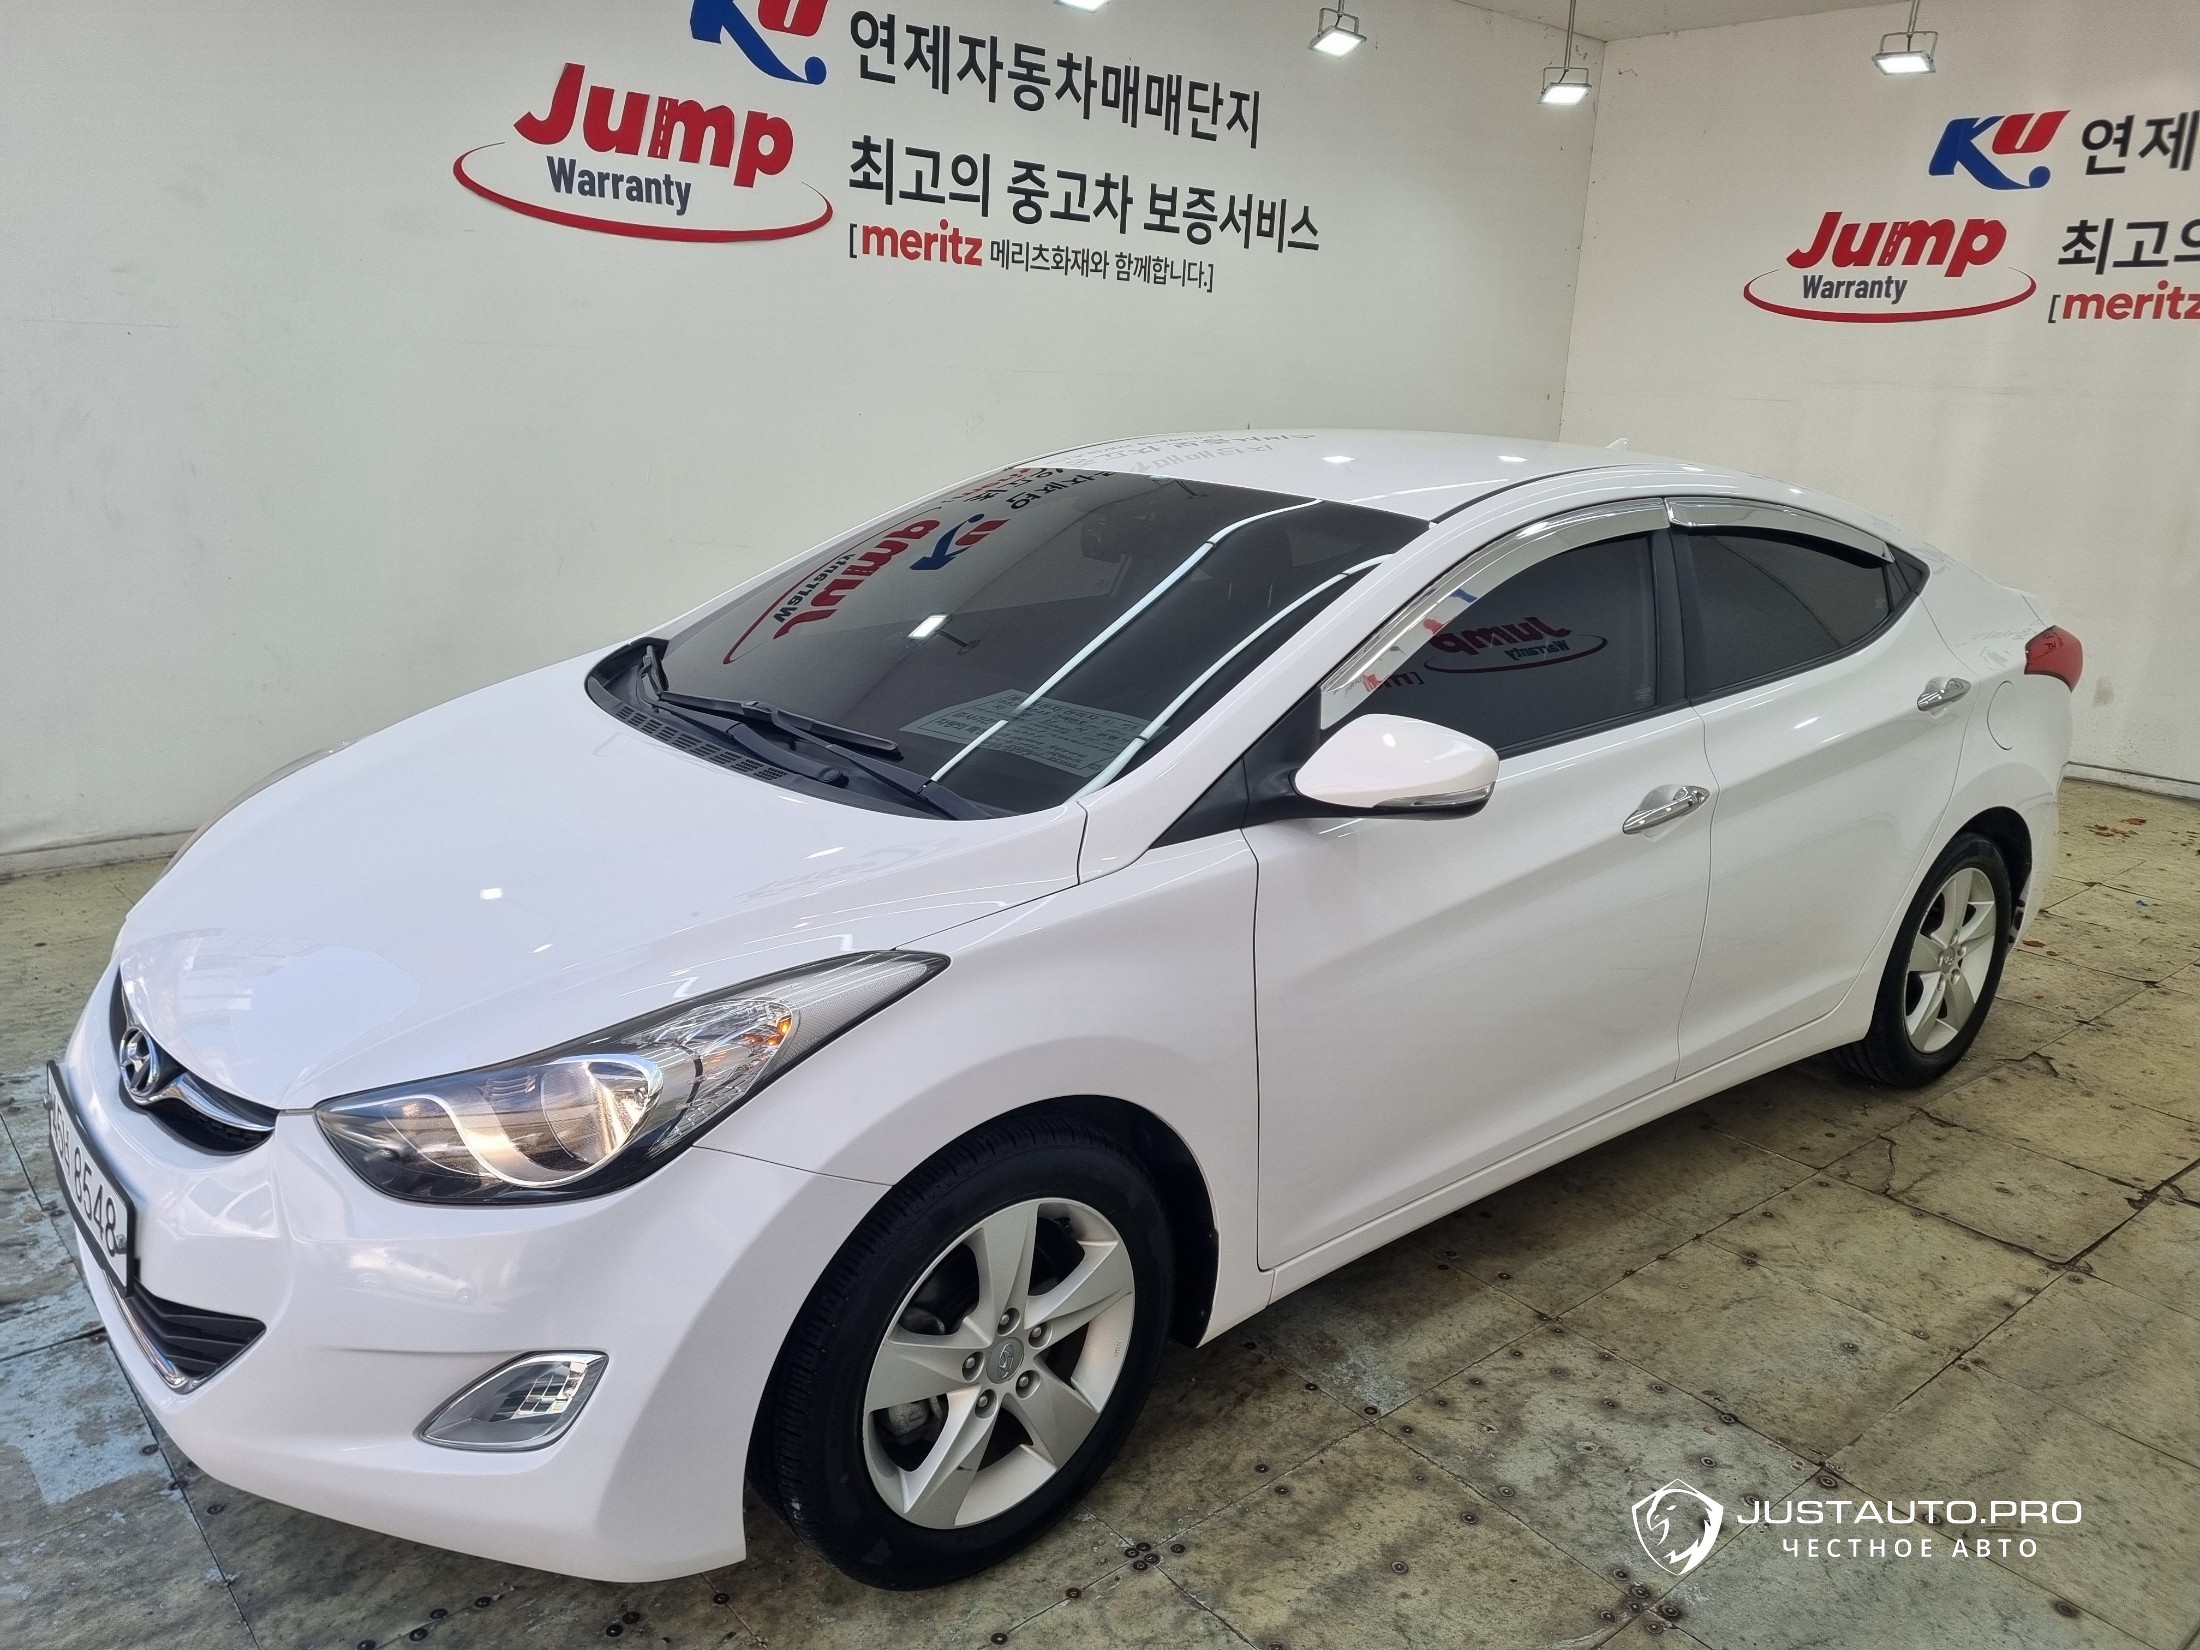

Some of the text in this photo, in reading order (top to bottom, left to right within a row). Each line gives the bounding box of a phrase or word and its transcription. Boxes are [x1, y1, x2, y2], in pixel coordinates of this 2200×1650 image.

[513, 62, 794, 188] Jump
[851, 11, 1260, 150] 연제자동차매매단지
[547, 155, 692, 216] Warranty
[849, 135, 1320, 254] 최고의 중고차 보증서비스
[990, 239, 1110, 280] 메리츠화재와
[1114, 251, 1215, 293] 함께합니다.]
[1786, 211, 2007, 278] Jump
[1803, 274, 1908, 304] Warranty
[74, 1146, 117, 1258] 8548
